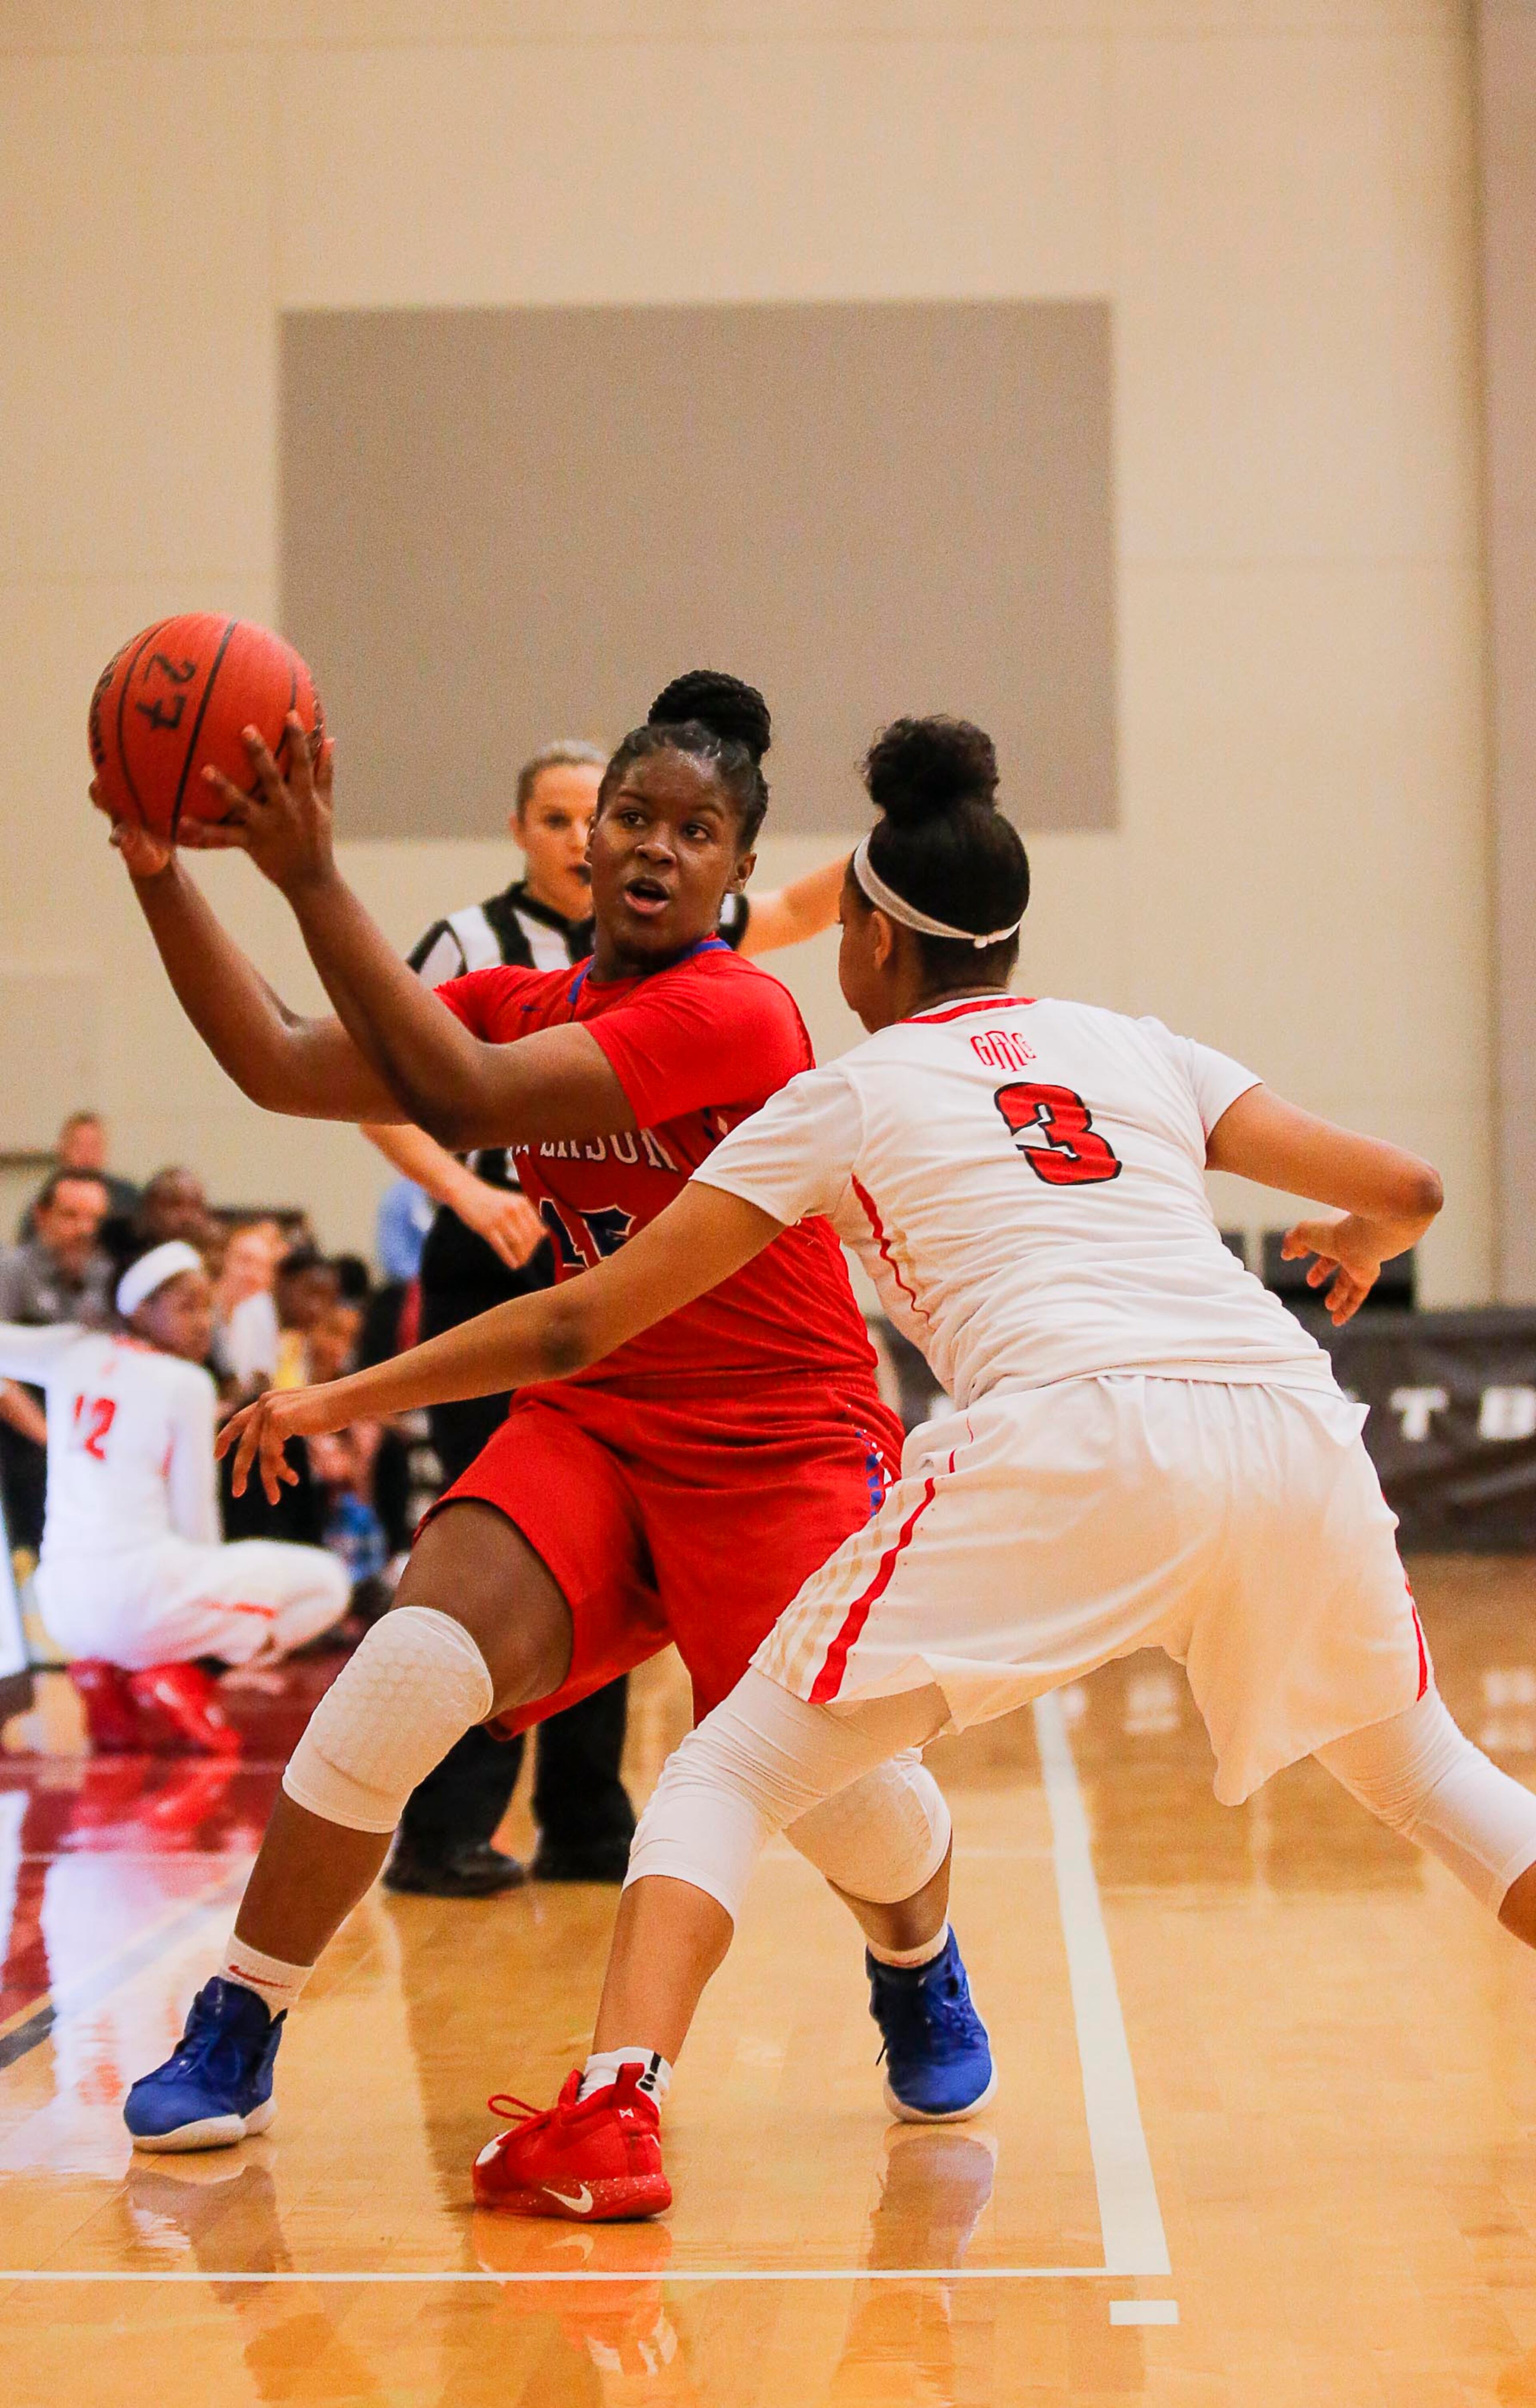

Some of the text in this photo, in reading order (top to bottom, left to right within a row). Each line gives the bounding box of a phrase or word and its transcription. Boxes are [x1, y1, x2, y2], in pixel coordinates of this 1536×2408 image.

[135, 653, 197, 730] 27
[994, 1081, 1122, 1186] 3
[74, 1393, 117, 1461] 12
